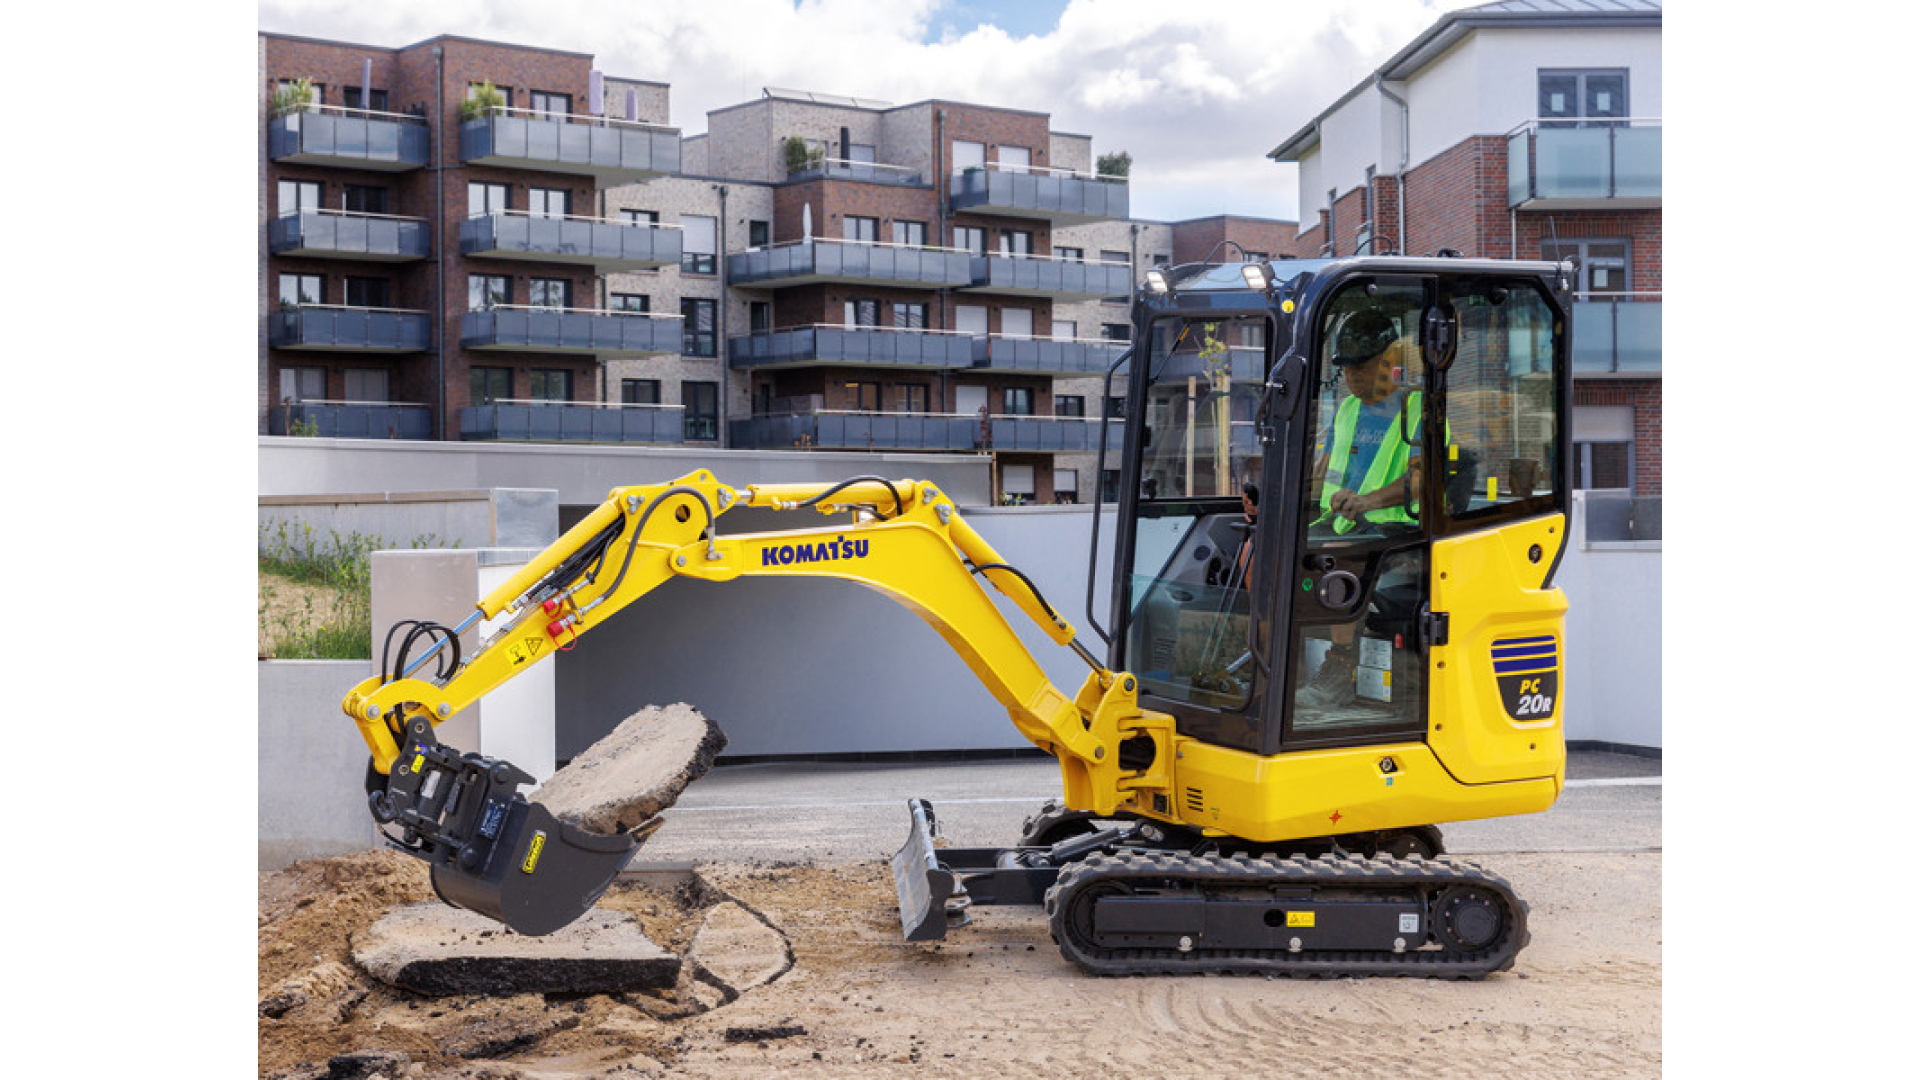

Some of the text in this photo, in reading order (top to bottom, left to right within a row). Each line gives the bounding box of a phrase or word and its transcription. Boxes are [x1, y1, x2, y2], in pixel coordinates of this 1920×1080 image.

[762, 535, 869, 566] KOMATSU
[1520, 678, 1541, 694] PC
[1516, 694, 1552, 715] 20R
